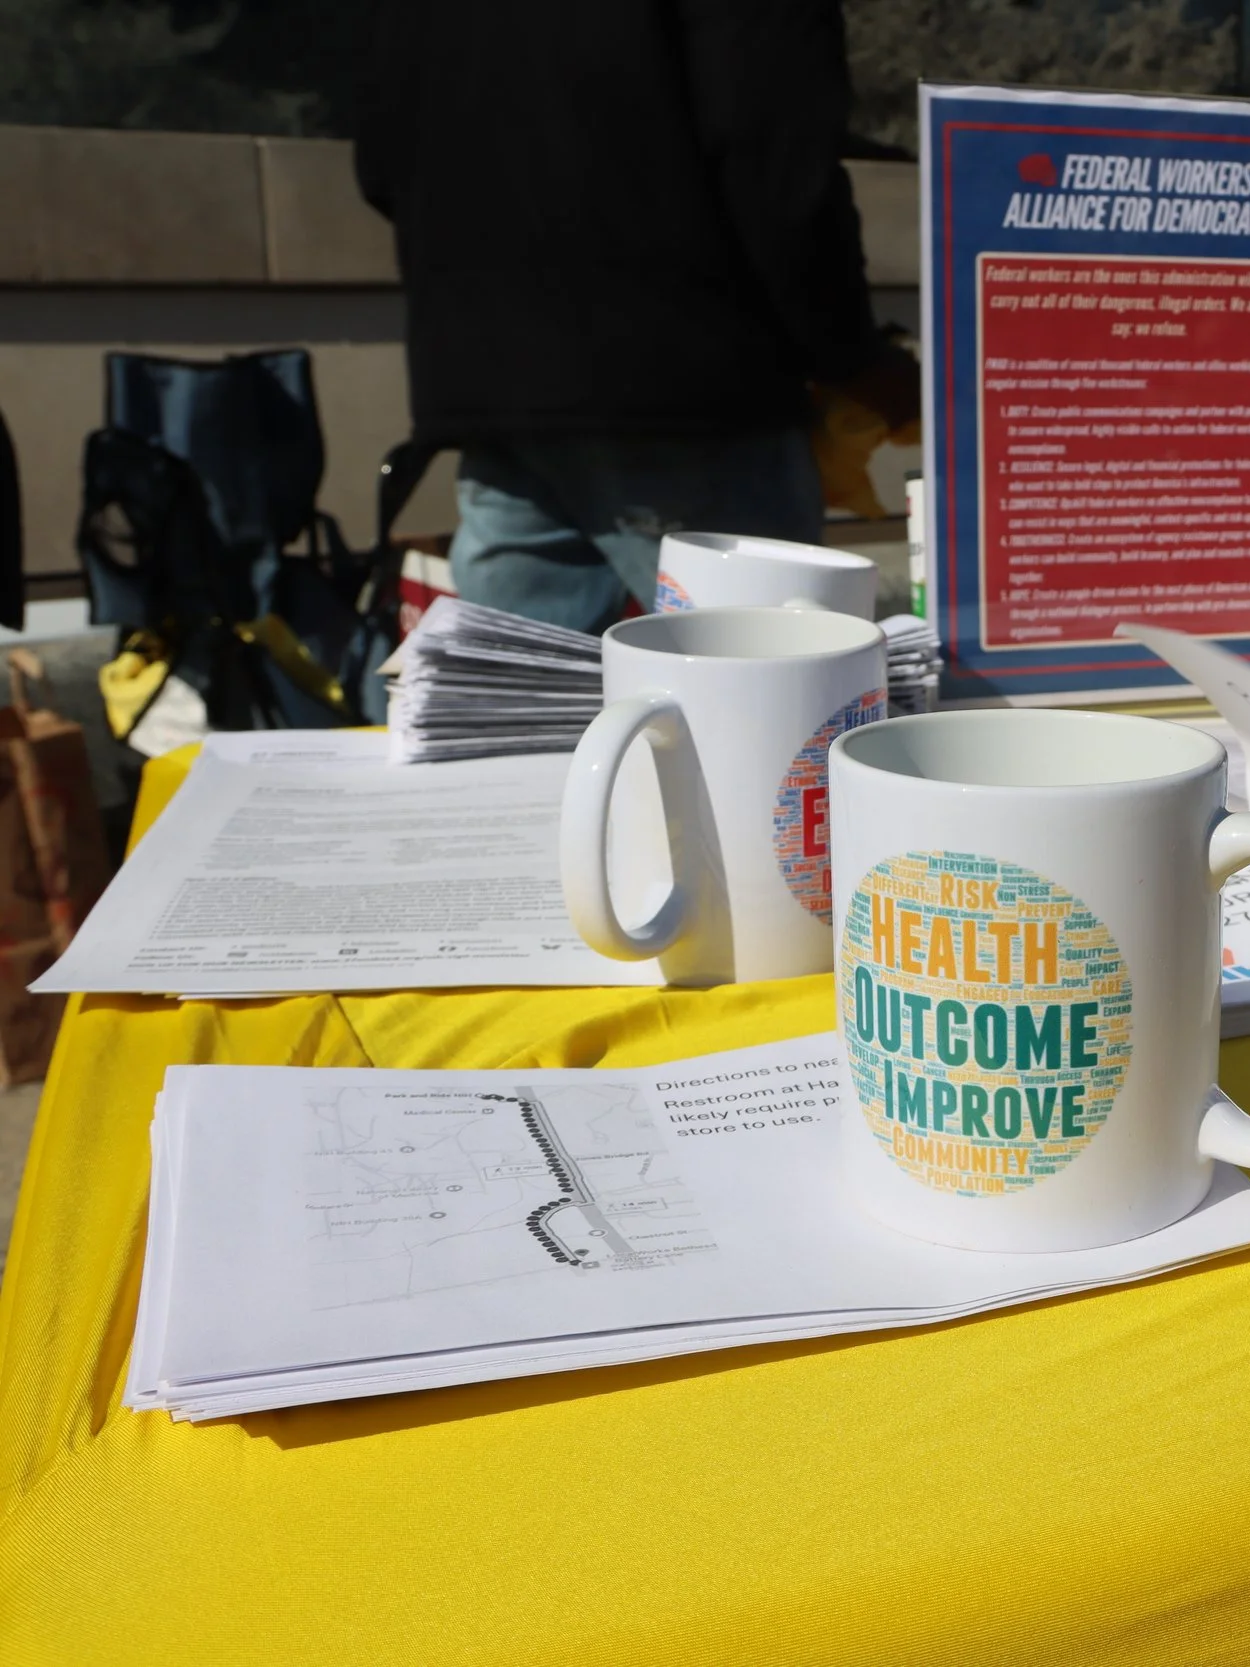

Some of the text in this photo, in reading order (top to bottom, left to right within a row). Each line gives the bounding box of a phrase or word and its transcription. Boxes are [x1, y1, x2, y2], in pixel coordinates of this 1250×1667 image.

[1061, 153, 1152, 192] FEDERAL
[1002, 192, 1111, 230] ALLIANCE
[1109, 196, 1151, 232] FOR
[928, 855, 998, 875] INTERVENTION
[872, 873, 927, 901] DIFFERENT
[939, 872, 1000, 910] RISK
[1017, 884, 1050, 896] STRESS
[1018, 901, 1072, 917] PREVENT
[1063, 918, 1097, 930] SUPPORT
[872, 892, 1058, 985] HEALTH
[1065, 947, 1103, 961] QUALITY
[1085, 960, 1120, 975] IMPACT
[1061, 977, 1089, 988] PEOPLE
[1092, 979, 1122, 996] CARE
[1100, 993, 1133, 1005] TREATMENT
[855, 965, 1099, 1071] OUTCOME
[1103, 1004, 1132, 1017] EXPAND
[851, 1046, 879, 1065] DEVELOP
[1106, 1046, 1121, 1057] LIFE
[655, 1067, 771, 1092] Directions
[775, 1062, 798, 1074] to
[1020, 1074, 1055, 1084] THROUGH
[1057, 1071, 1082, 1081] ACCESS
[1090, 1065, 1123, 1078] ENHANCE
[663, 1079, 840, 1110] Restroom at Ha
[884, 1059, 1086, 1139] IMPROVE
[669, 1110, 730, 1124] likely
[735, 1098, 817, 1117] require
[676, 1112, 822, 1138] store to use.
[892, 1125, 1030, 1176] COMMUNITY
[927, 1167, 1004, 1193] POPULATION
